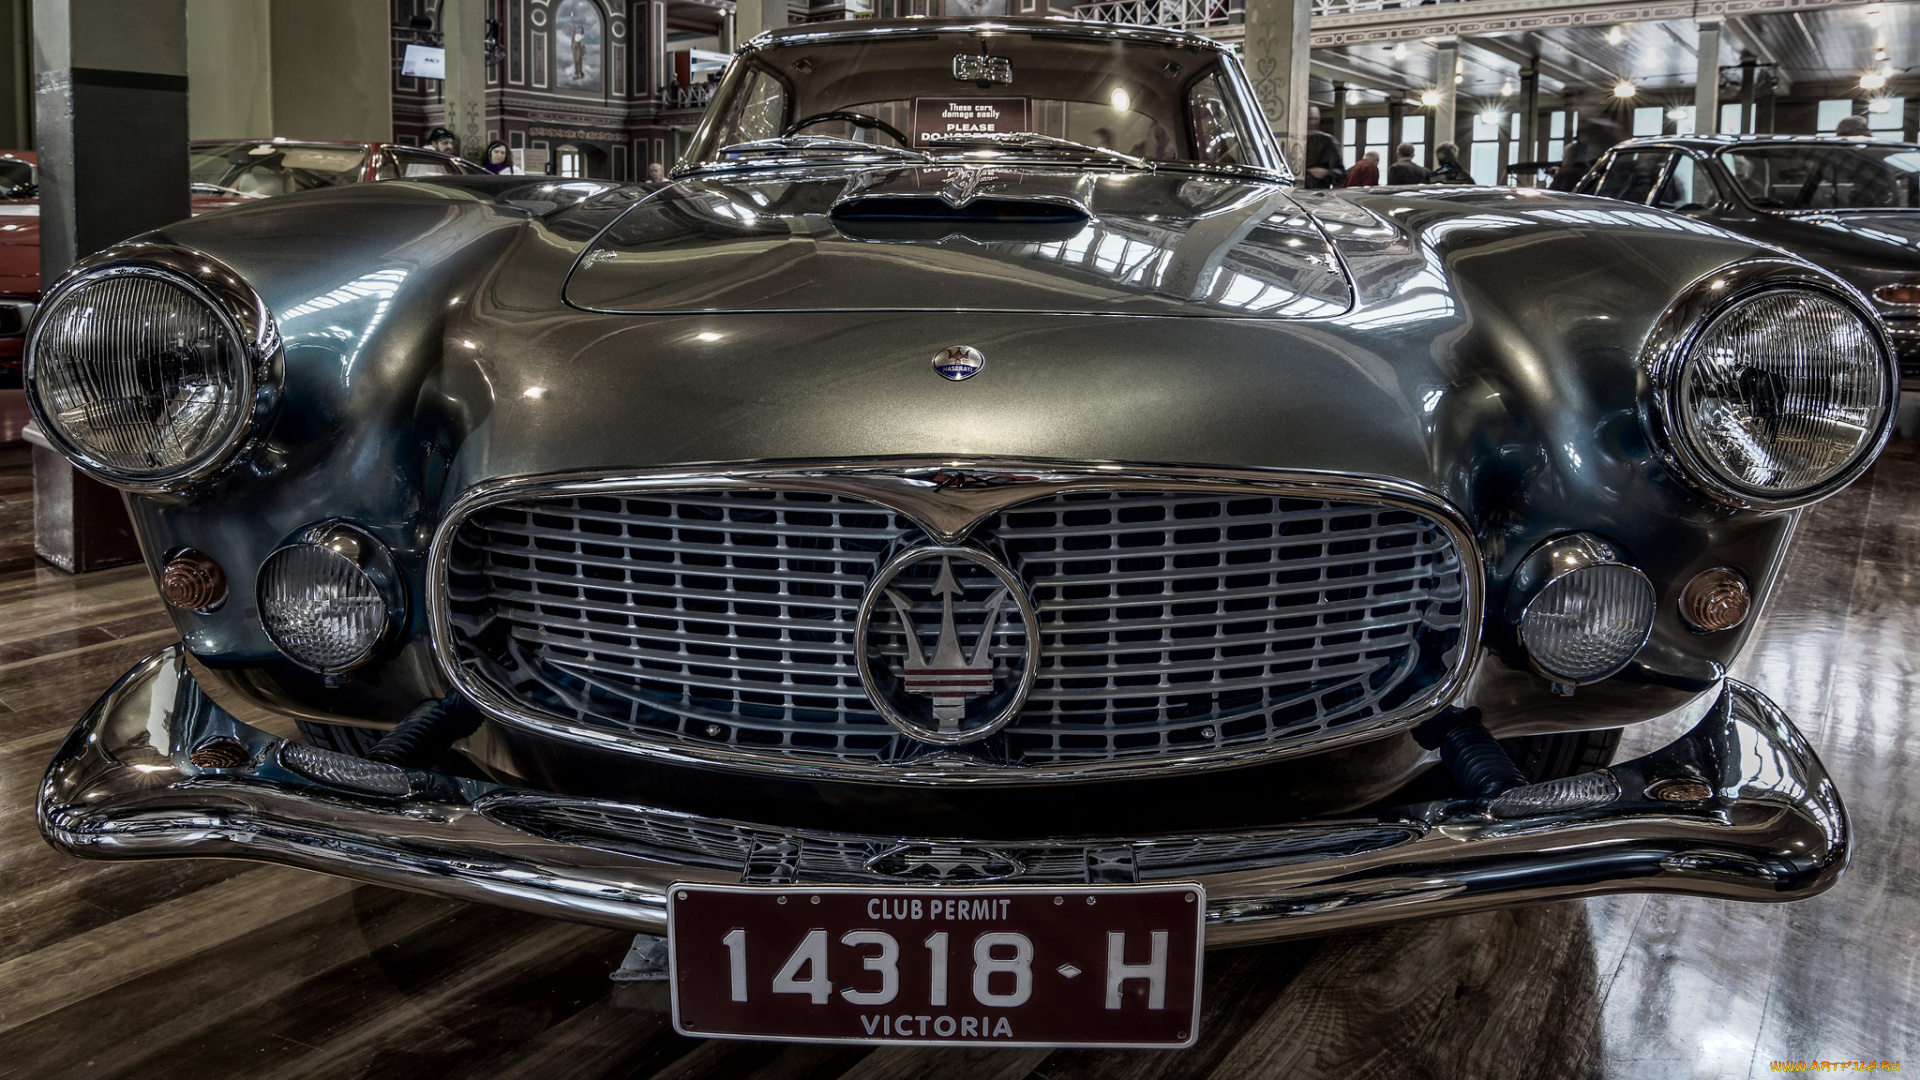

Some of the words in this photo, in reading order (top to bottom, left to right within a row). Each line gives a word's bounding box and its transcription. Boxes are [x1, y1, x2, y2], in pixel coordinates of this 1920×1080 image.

[942, 110, 973, 119] damage
[977, 110, 1000, 119] easily
[949, 103, 972, 111] These
[921, 133, 941, 141] DO
[867, 898, 924, 920] CLUB
[930, 899, 1011, 920] PERMIT
[722, 928, 1035, 1007] 14318
[860, 1014, 1014, 1038] VICTORIA
